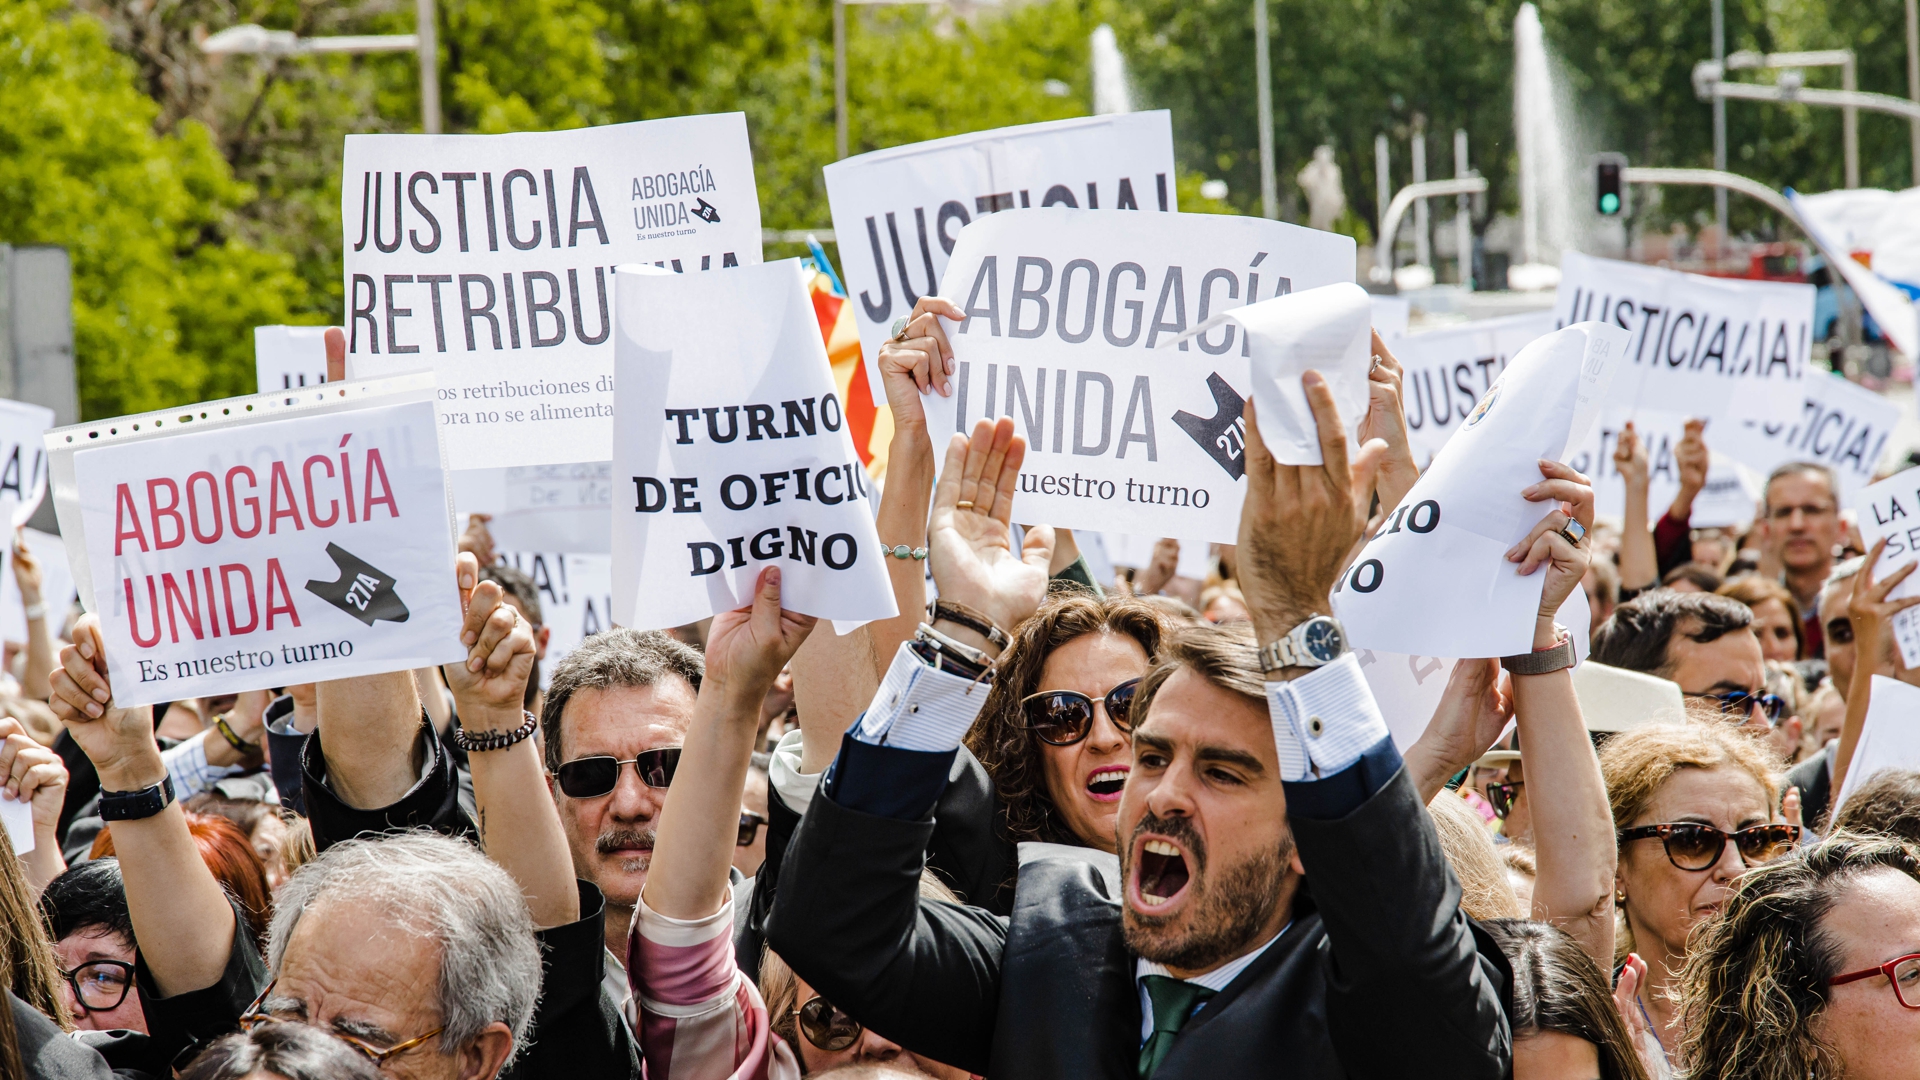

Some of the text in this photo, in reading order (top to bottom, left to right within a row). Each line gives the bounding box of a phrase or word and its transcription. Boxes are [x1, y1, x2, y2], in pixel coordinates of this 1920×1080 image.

[631, 163, 716, 201] ABOGACÍA
[353, 166, 610, 254] JUSTICIA
[633, 201, 690, 230] UNIDA
[636, 227, 697, 241] Es nuestro turno
[349, 251, 741, 355] RETRIBU
[958, 251, 1292, 358] ABOGACÍ
[463, 379, 590, 399] retribuciones
[595, 375, 614, 392] di
[475, 411, 499, 424] no
[505, 409, 525, 423] se
[530, 402, 614, 421] alimenta
[664, 392, 842, 445] TURNO
[956, 361, 1158, 462] UNIDA
[114, 433, 400, 556] ABOGACÍA
[632, 476, 702, 513] DE
[1125, 477, 1211, 510] turno
[1872, 495, 1908, 526] LA
[686, 525, 858, 577] DIGNO
[123, 557, 302, 648] UNIDA
[344, 571, 381, 612] 27A
[136, 639, 354, 683] Es nuestro turno
